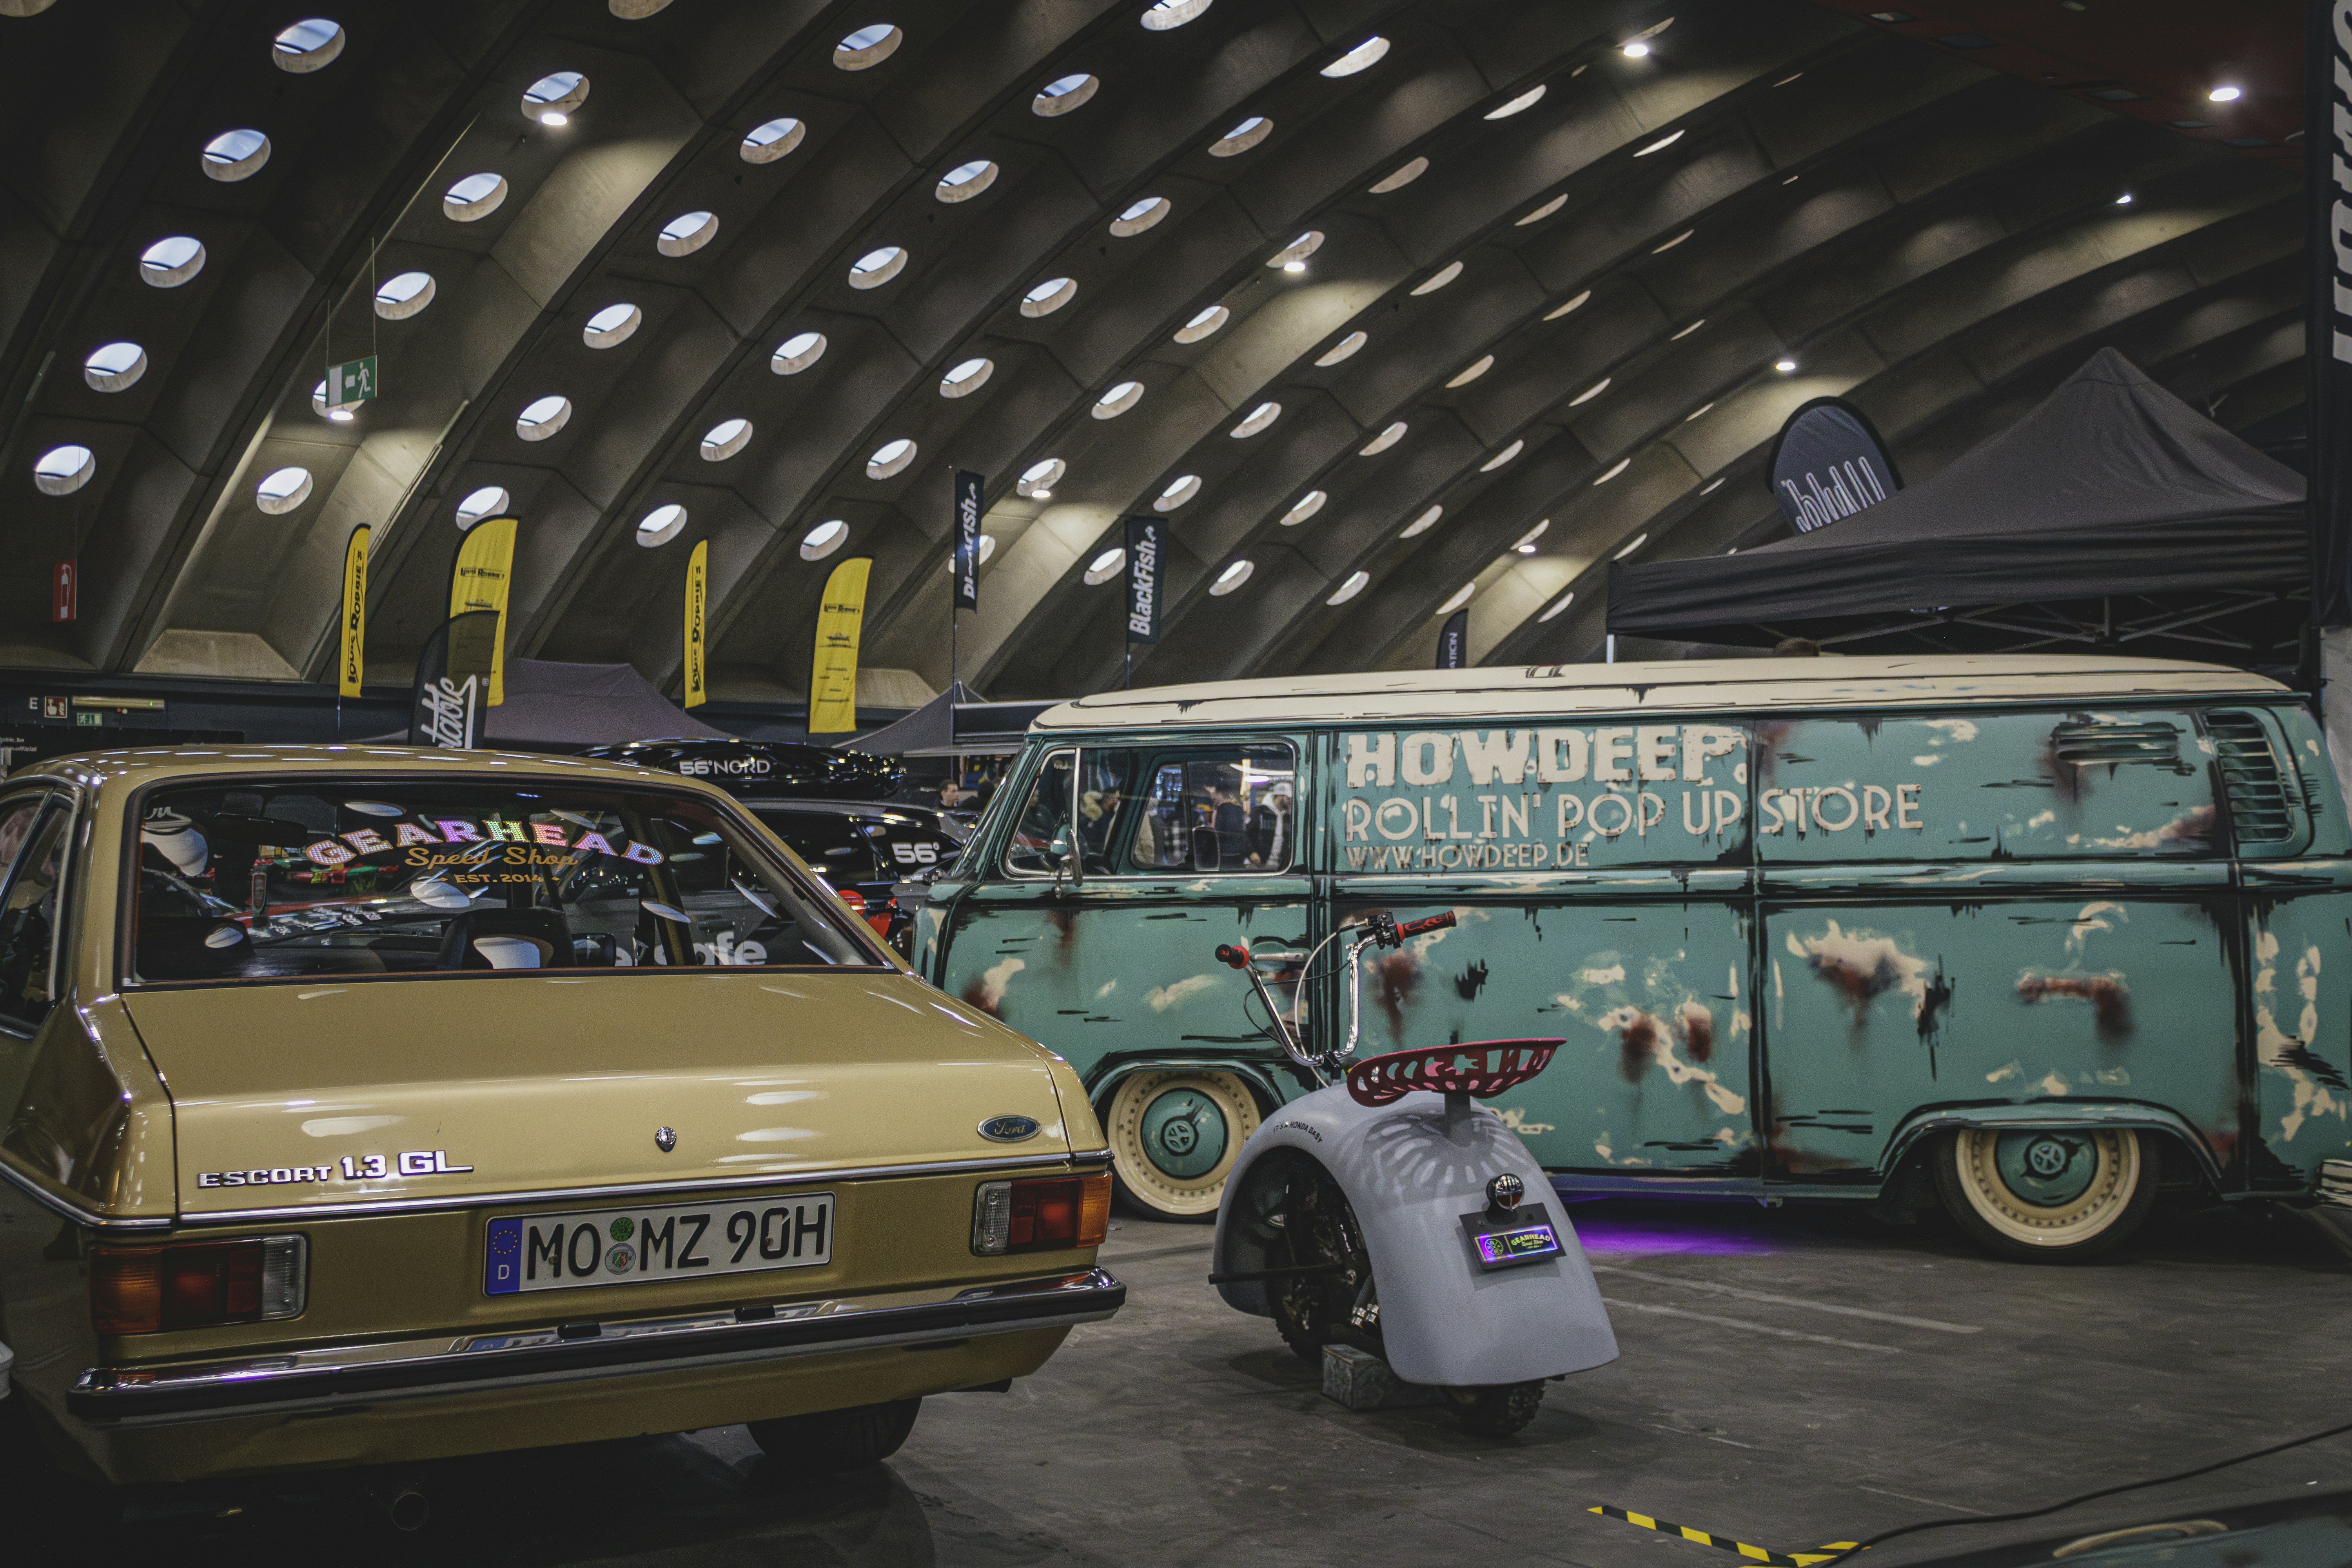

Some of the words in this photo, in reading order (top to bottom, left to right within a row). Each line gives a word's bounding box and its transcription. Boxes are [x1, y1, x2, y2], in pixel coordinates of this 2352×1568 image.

[1129, 539, 1156, 636] BlackFish
[29, 696, 38, 709] E
[1346, 792, 1541, 842] ROLLIN'
[1557, 791, 1666, 838] POP
[1683, 790, 1742, 835] UP
[1760, 784, 1923, 833] STORE
[305, 819, 664, 865] GEARHEAD
[405, 847, 493, 869] Speed
[503, 847, 579, 871] Shop
[1345, 843, 1589, 870] WWW.HOWDEEP.DE
[995, 1121, 1025, 1135] Ford
[1290, 1122, 1308, 1132] HONDA
[198, 1165, 331, 1189] ESCORT
[341, 1154, 387, 1180] 1.3
[398, 1150, 474, 1176] GL
[527, 1223, 601, 1280] MO
[639, 1214, 711, 1271] MZ
[726, 1203, 827, 1263] 90H
[1511, 1234, 1551, 1246] GEARHEAD
[497, 1263, 510, 1281] D
